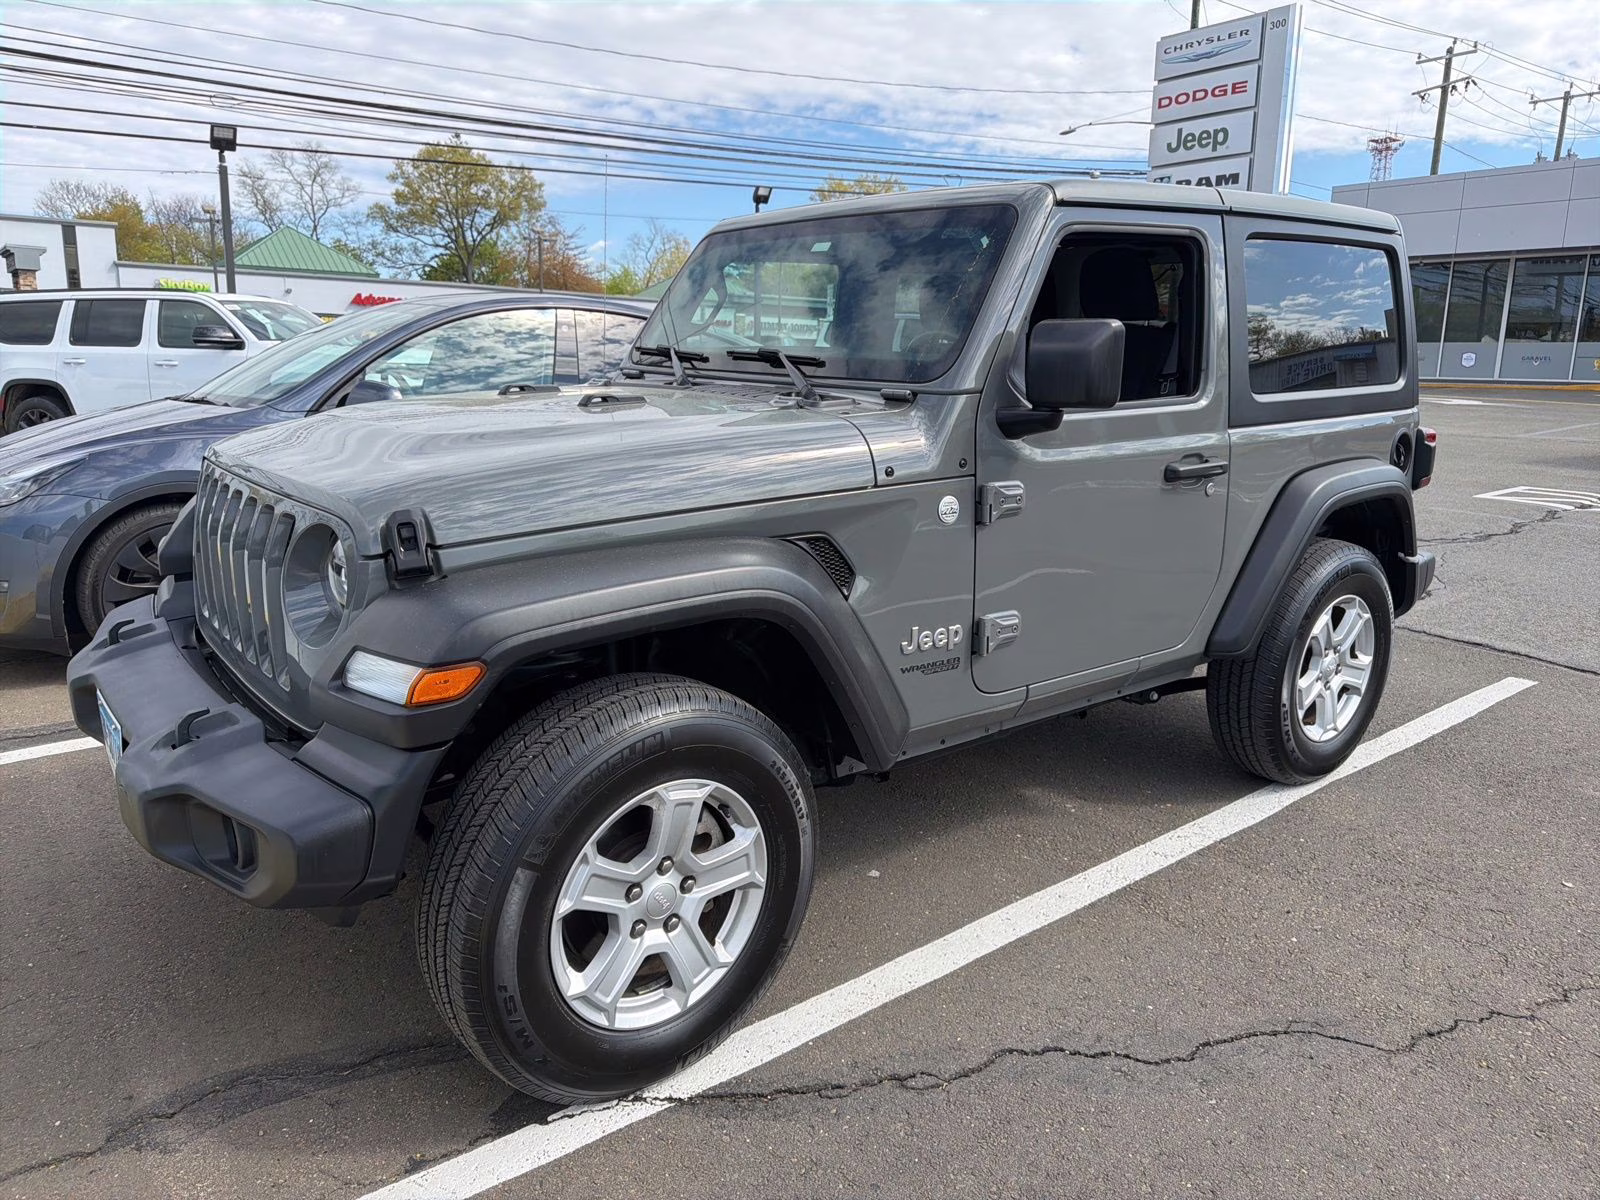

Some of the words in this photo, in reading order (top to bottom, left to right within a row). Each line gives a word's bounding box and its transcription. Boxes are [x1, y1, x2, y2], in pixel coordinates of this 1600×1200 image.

[1269, 18, 1287, 31] 300
[1163, 28, 1251, 54] CHRYSLER
[1157, 80, 1249, 110] DODGE
[1166, 126, 1230, 154] Jeep
[351, 293, 408, 305] Advan
[900, 624, 963, 655] Jeep
[900, 656, 961, 675] WRANGLER
[554, 731, 664, 827] CHELIN
